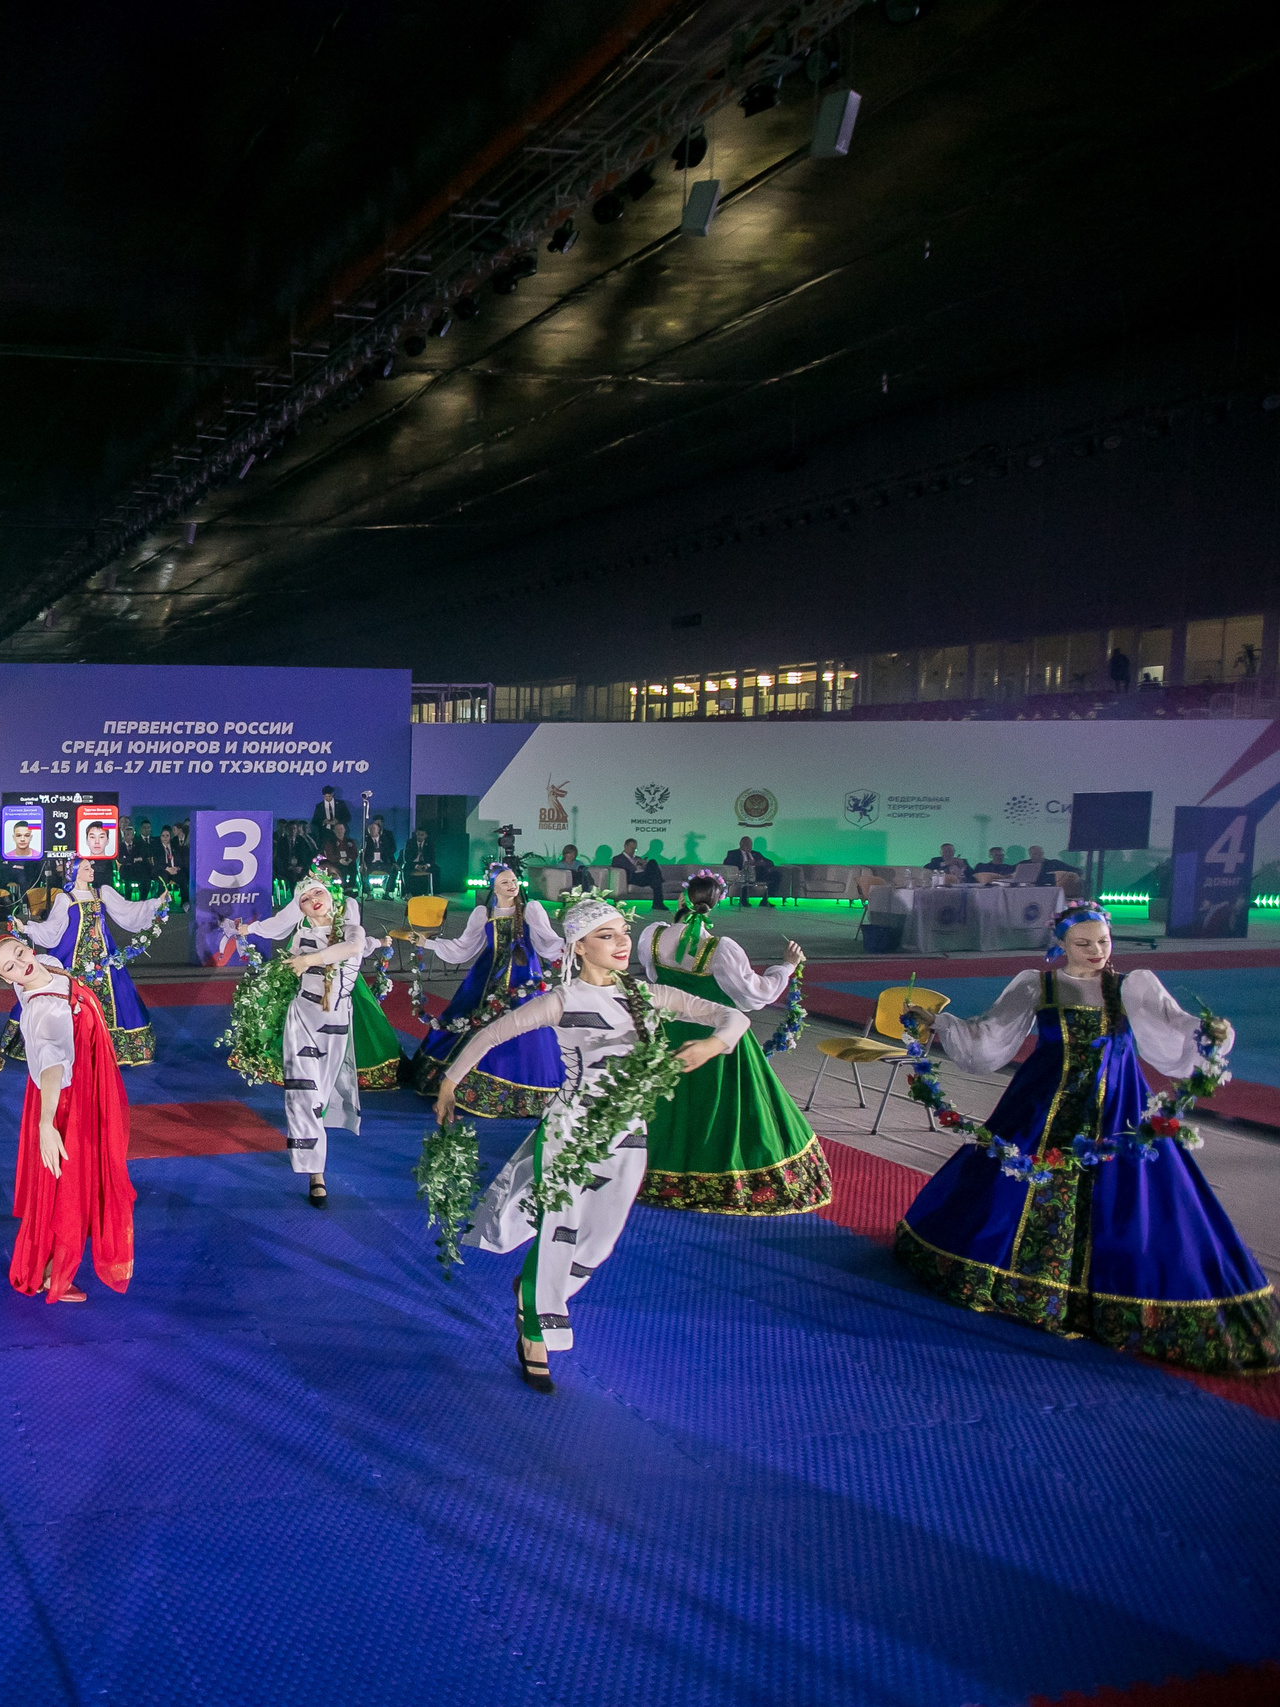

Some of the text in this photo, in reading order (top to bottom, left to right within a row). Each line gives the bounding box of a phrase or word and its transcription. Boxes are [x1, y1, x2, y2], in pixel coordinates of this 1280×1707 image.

[103, 720, 294, 735] ПЕРВЕНСТВО РОССИИ
[61, 740, 333, 757] СРЕДИ ЮНИОРОВ И ЮНИОРОК
[75, 760, 89, 774] И
[148, 760, 184, 774] ЛЕТ
[187, 760, 214, 774] ПО
[219, 760, 328, 776] ТХЭКВОНДО
[331, 759, 370, 774] ИТФ
[52, 810, 69, 819] Ring
[539, 807, 556, 822] 80
[54, 821, 67, 839] 3
[1204, 815, 1247, 874] 4
[208, 818, 262, 889] 3
[209, 893, 260, 907] ДОЯНГ
